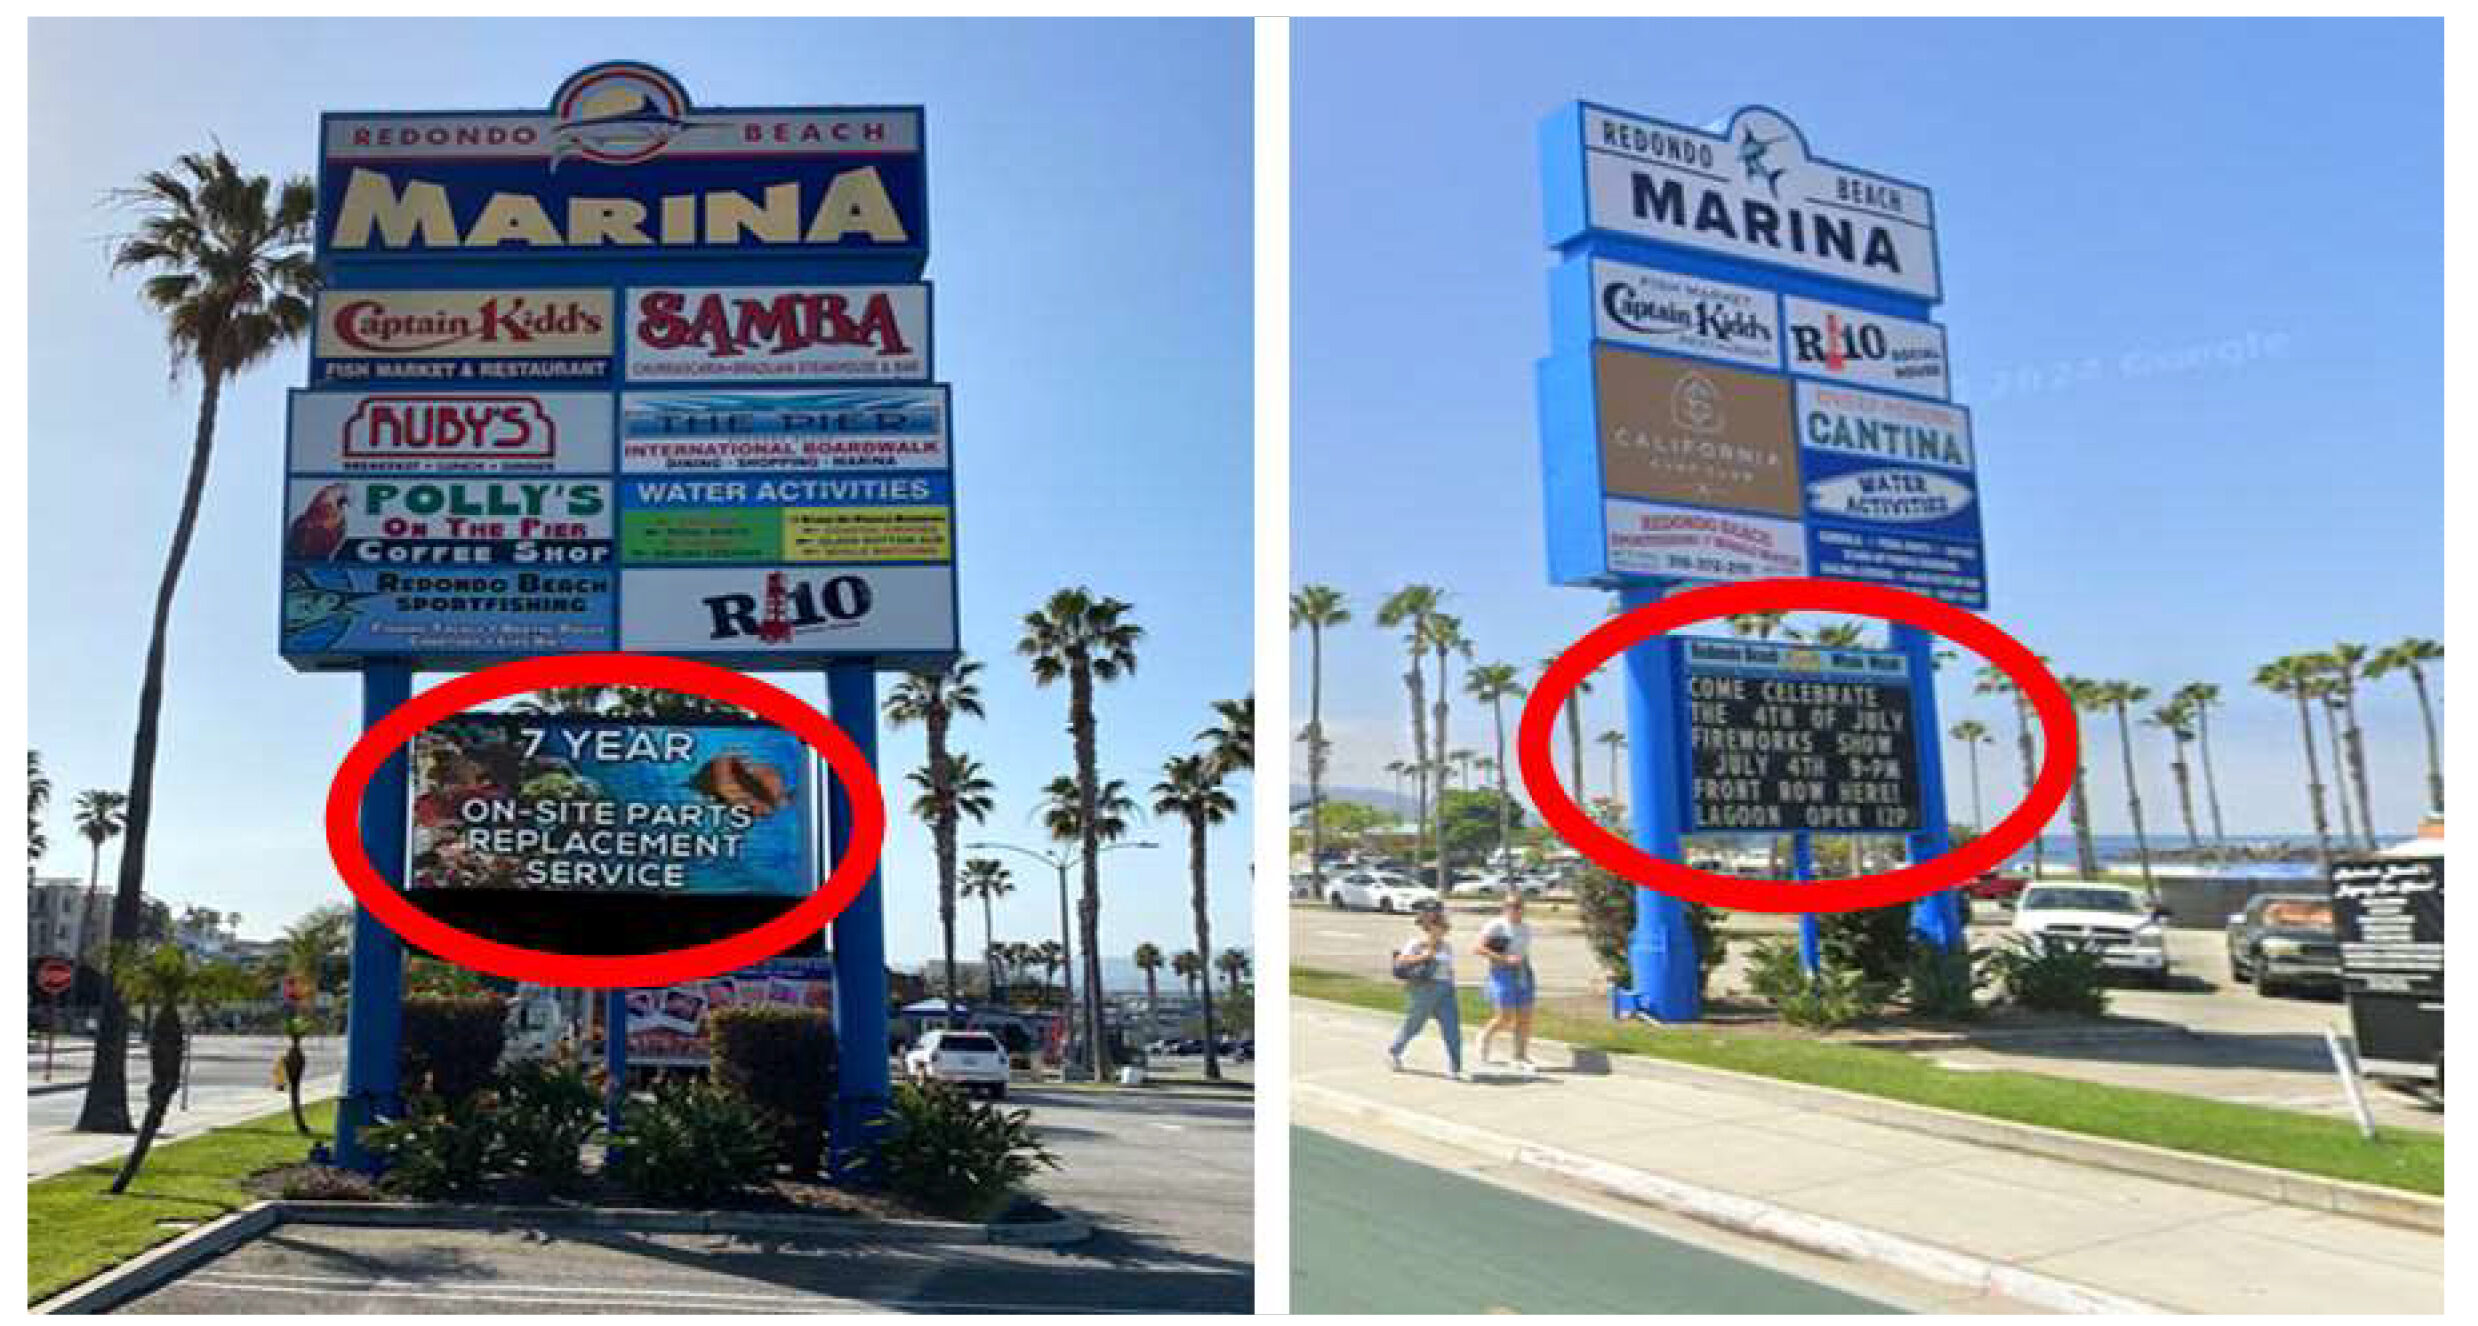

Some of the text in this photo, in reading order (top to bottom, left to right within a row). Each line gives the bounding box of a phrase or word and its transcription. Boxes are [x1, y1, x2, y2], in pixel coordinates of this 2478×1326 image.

[353, 122, 886, 147] REDONDO BEACH
[1602, 121, 1714, 168] REDONDO
[330, 165, 909, 249] MARINA
[1836, 176, 1901, 212] BEACH
[1631, 171, 1904, 274] MARINA
[1603, 281, 1692, 335] Captain
[334, 297, 602, 353] Captain Kidd's
[637, 291, 912, 359] SAMBA
[326, 361, 369, 377] FISH
[375, 361, 455, 378] MARKET
[480, 361, 606, 378] RESTAURANT
[367, 403, 532, 448] RUBY'S
[658, 412, 910, 434] THE PIER
[1808, 411, 1966, 465] CANTINA
[624, 441, 940, 457] INTERNATIONAL BOARDWALK
[1613, 426, 1780, 467] CALIFORNIA
[365, 482, 604, 515] POLLY'S
[637, 479, 930, 503] WATER ACTIVITIES
[1857, 474, 1927, 494] WATER
[1844, 492, 1949, 514] ACTIVITIES
[396, 596, 587, 613] SPORTFISHING
[1691, 677, 1878, 707] COME CELEBRATE
[1691, 702, 1904, 732] THE 4TH OF JULY
[519, 729, 698, 762] 7 YEAR
[1691, 727, 1892, 755] FIREWORKS SHOW
[1715, 754, 1770, 778] JULY
[1787, 757, 1826, 779] 4TH
[1691, 778, 1762, 802] FRONT
[1778, 780, 1825, 801] ROW
[461, 798, 752, 829] ON-SITE PARTS
[1692, 803, 1782, 827] LAGOON
[1805, 806, 1861, 828] OPEN
[469, 830, 742, 858] REPLACEMENT
[525, 860, 684, 888] SERVICE
